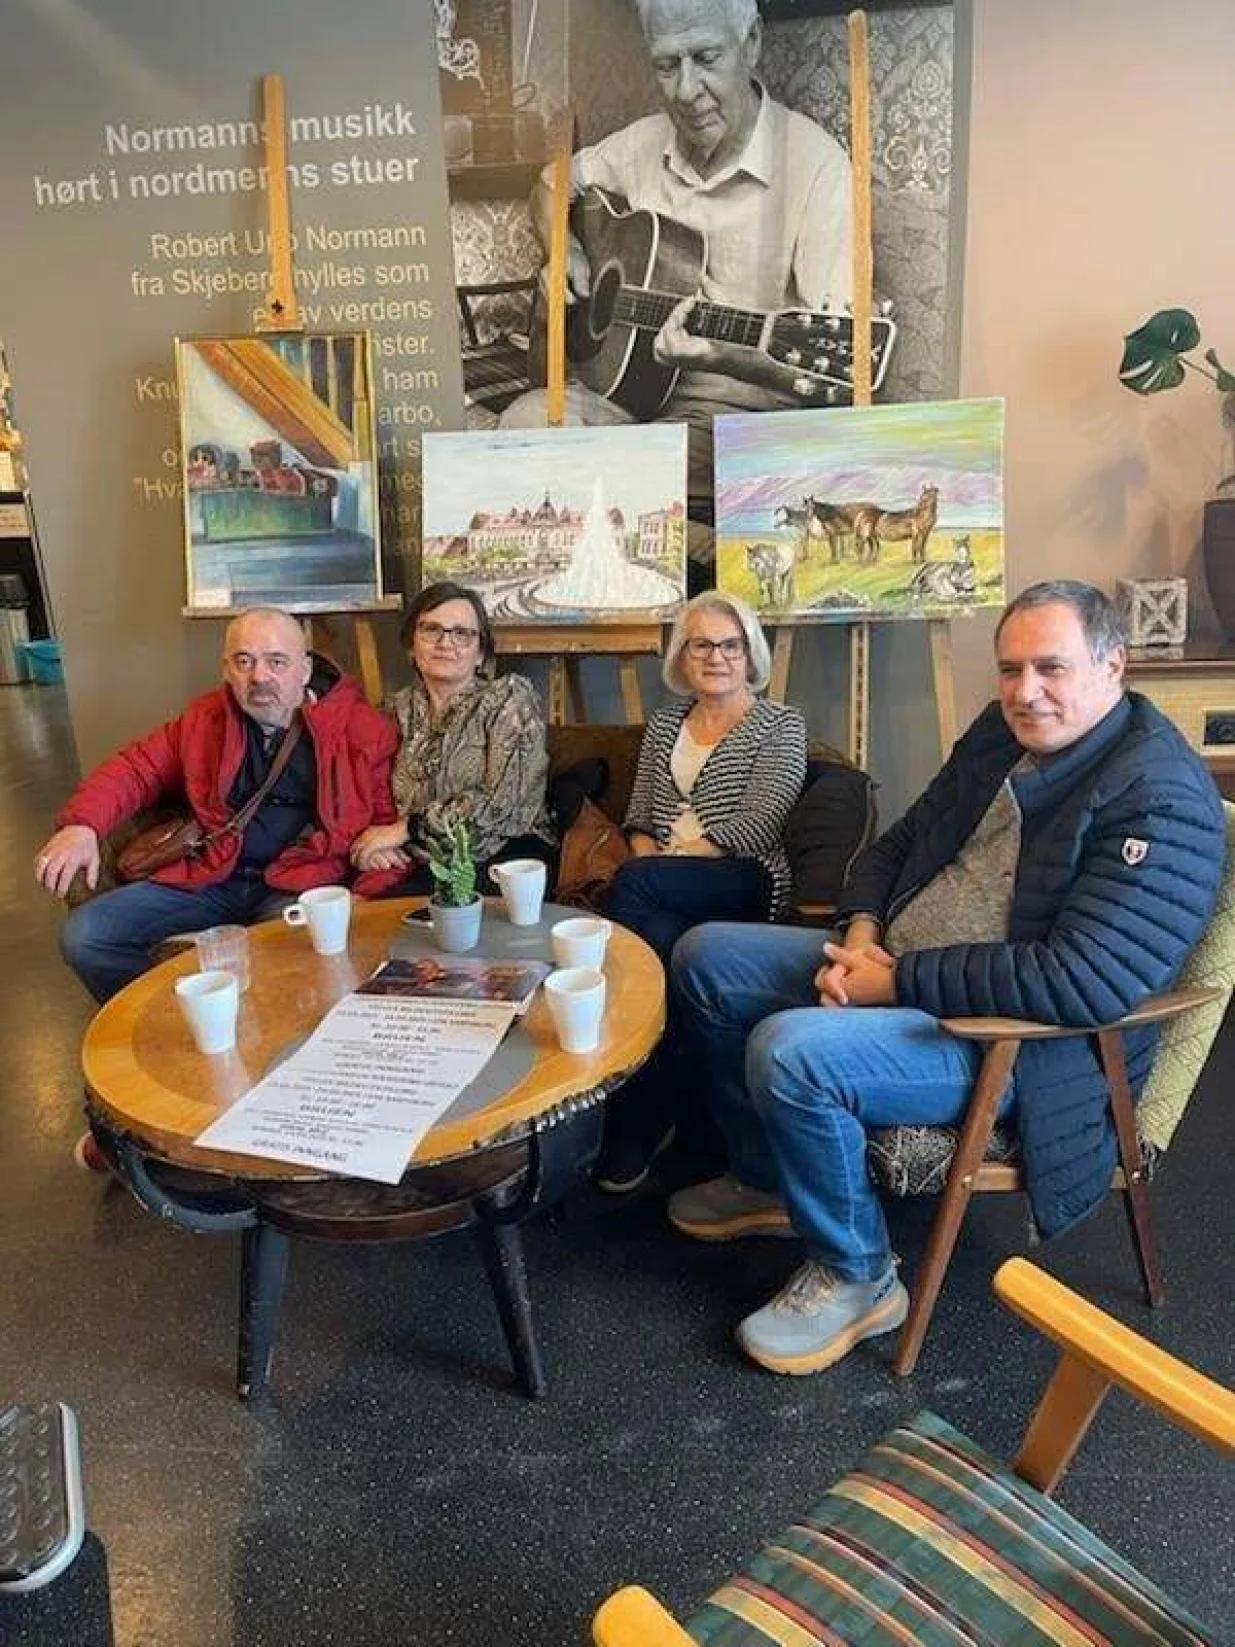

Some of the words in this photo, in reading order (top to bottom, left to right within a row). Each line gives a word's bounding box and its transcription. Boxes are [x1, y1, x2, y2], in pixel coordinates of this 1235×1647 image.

[290, 102, 416, 142] musikk
[34, 172, 102, 206] hørt
[109, 169, 119, 199] i
[330, 154, 420, 185] stuer
[150, 231, 238, 259] Robert
[244, 229, 298, 255] Uo
[305, 223, 427, 252] Normann
[131, 271, 166, 297] fra
[375, 262, 429, 285] som
[329, 296, 433, 323] verdens
[382, 366, 439, 391] ham
[379, 400, 441, 427] arbo,
